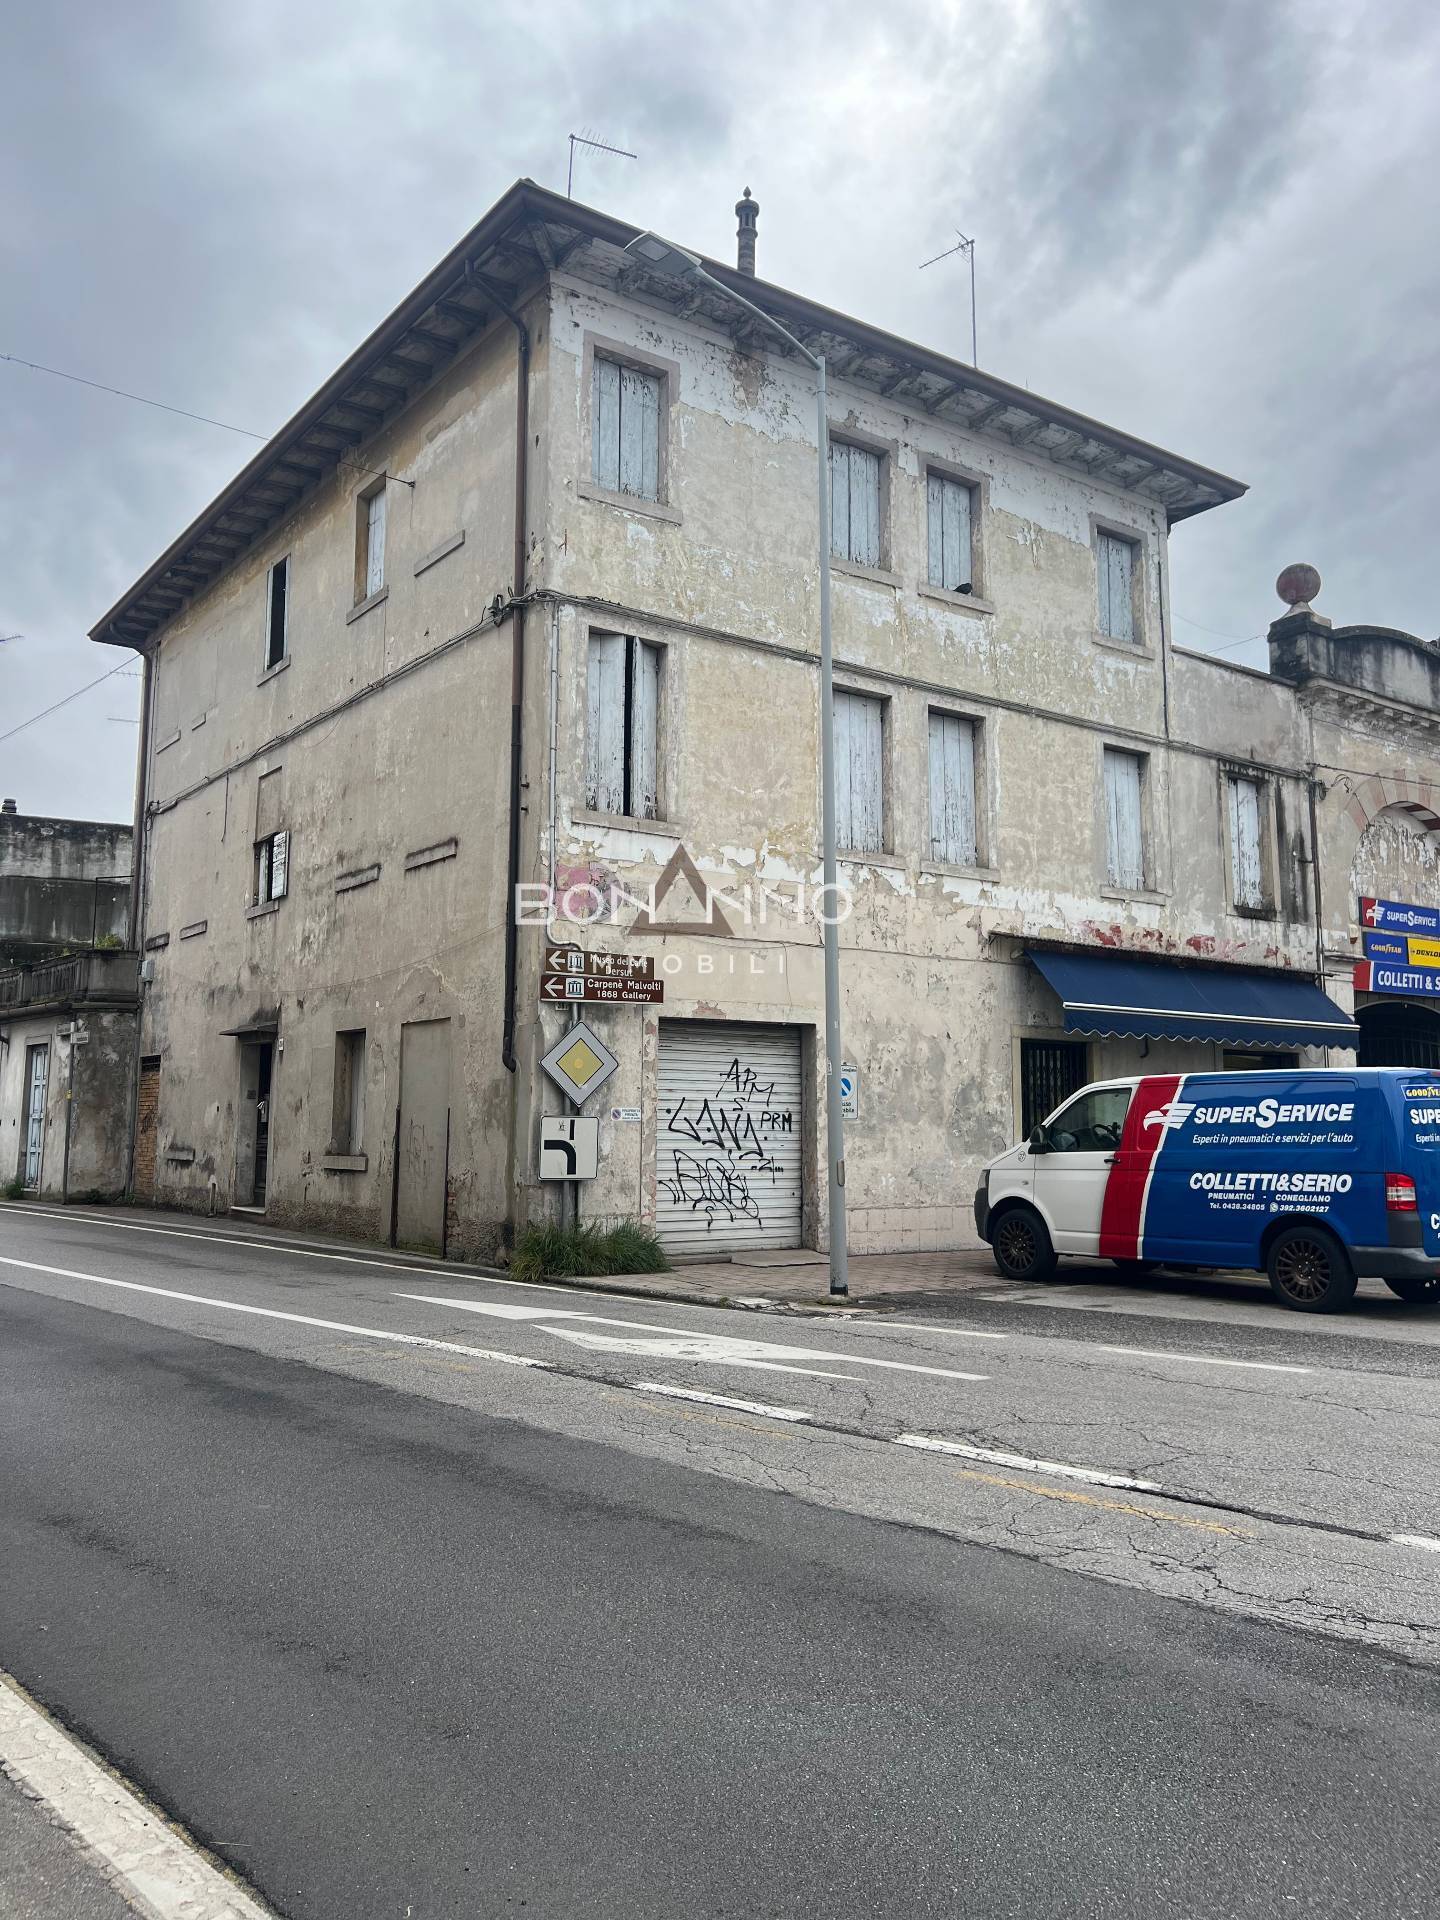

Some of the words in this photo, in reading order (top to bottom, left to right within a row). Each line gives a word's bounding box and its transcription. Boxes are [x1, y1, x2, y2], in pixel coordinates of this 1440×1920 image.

[587, 978, 623, 990] Carpenè
[627, 981, 661, 991] Malvolti
[1378, 970, 1423, 988] COLLETTI
[1425, 976, 1433, 990] &
[597, 990, 618, 999] 1868
[622, 992, 651, 1001] Gallery
[760, 1110, 793, 1133] PRM
[1192, 1134, 1220, 1145] Esperti
[1220, 1134, 1229, 1143] in
[1229, 1133, 1275, 1145] pneumatici
[1275, 1135, 1280, 1143] e
[1281, 1133, 1310, 1143] servizi
[1310, 1135, 1327, 1144] per
[1189, 1172, 1353, 1193] COLLETTI&SERIO
[1207, 1192, 1255, 1201] PNEUMATICI
[1275, 1193, 1332, 1203] CONEGLIANO
[1209, 1202, 1222, 1210] Tel.
